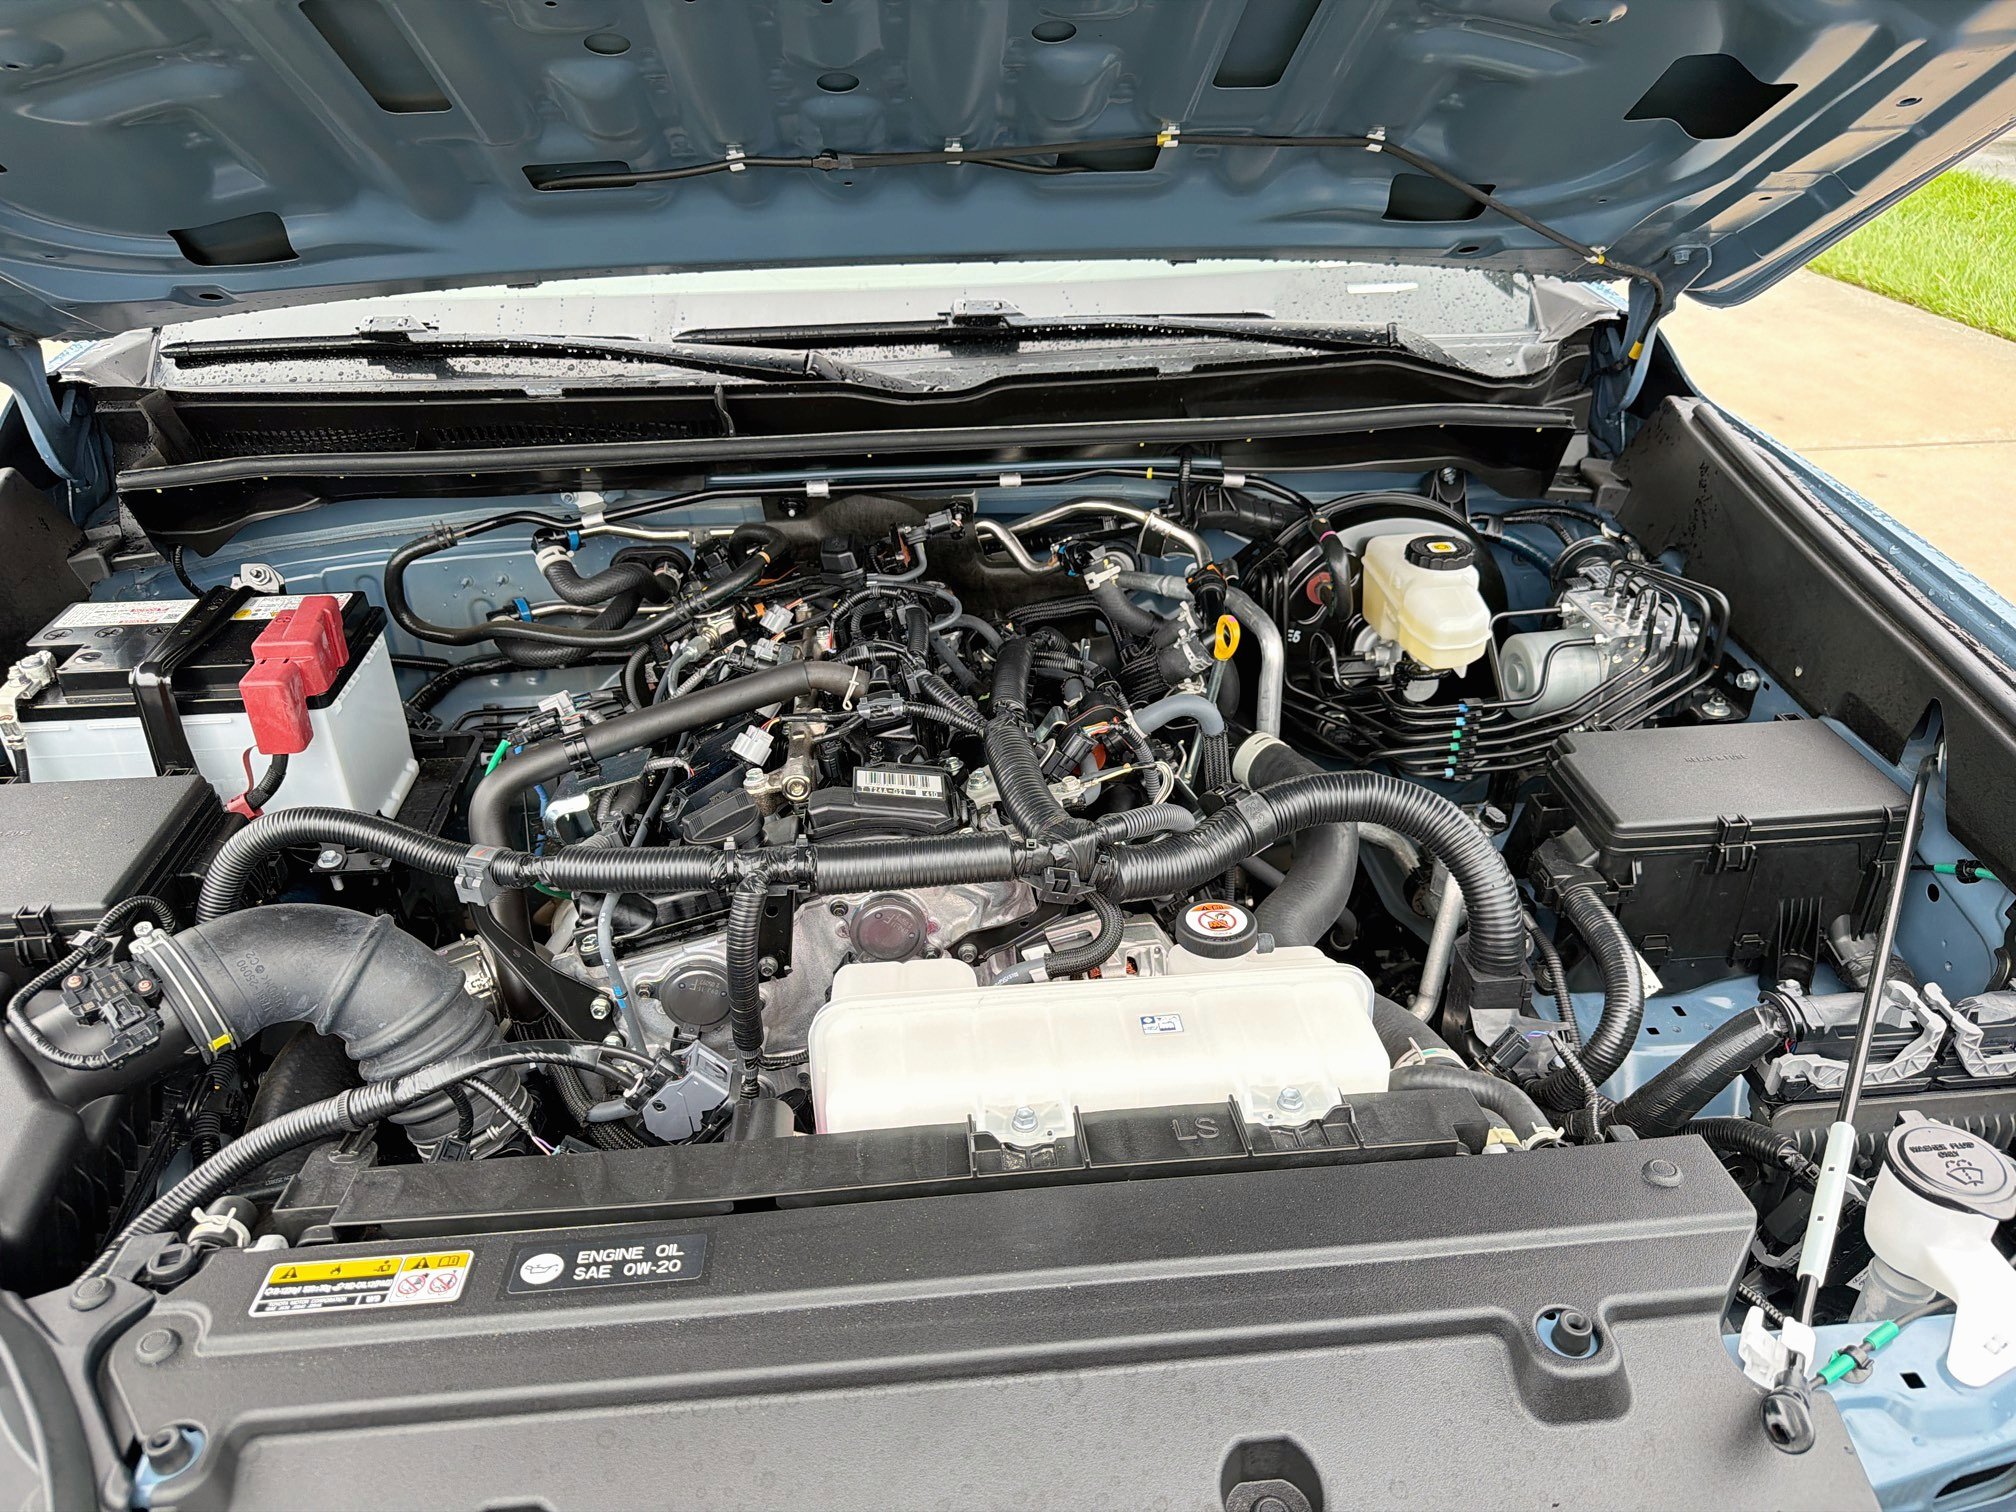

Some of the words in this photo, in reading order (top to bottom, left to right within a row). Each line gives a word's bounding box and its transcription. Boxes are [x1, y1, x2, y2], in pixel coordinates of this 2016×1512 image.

[1171, 1117, 1219, 1140] LS
[1909, 1144, 1947, 1153] WASHER
[1949, 1142, 1974, 1150] FLUID
[576, 1246, 644, 1264] ENGINE
[655, 1243, 684, 1257] OIL
[573, 1265, 612, 1280] SAE
[623, 1259, 681, 1276] 0W-20
